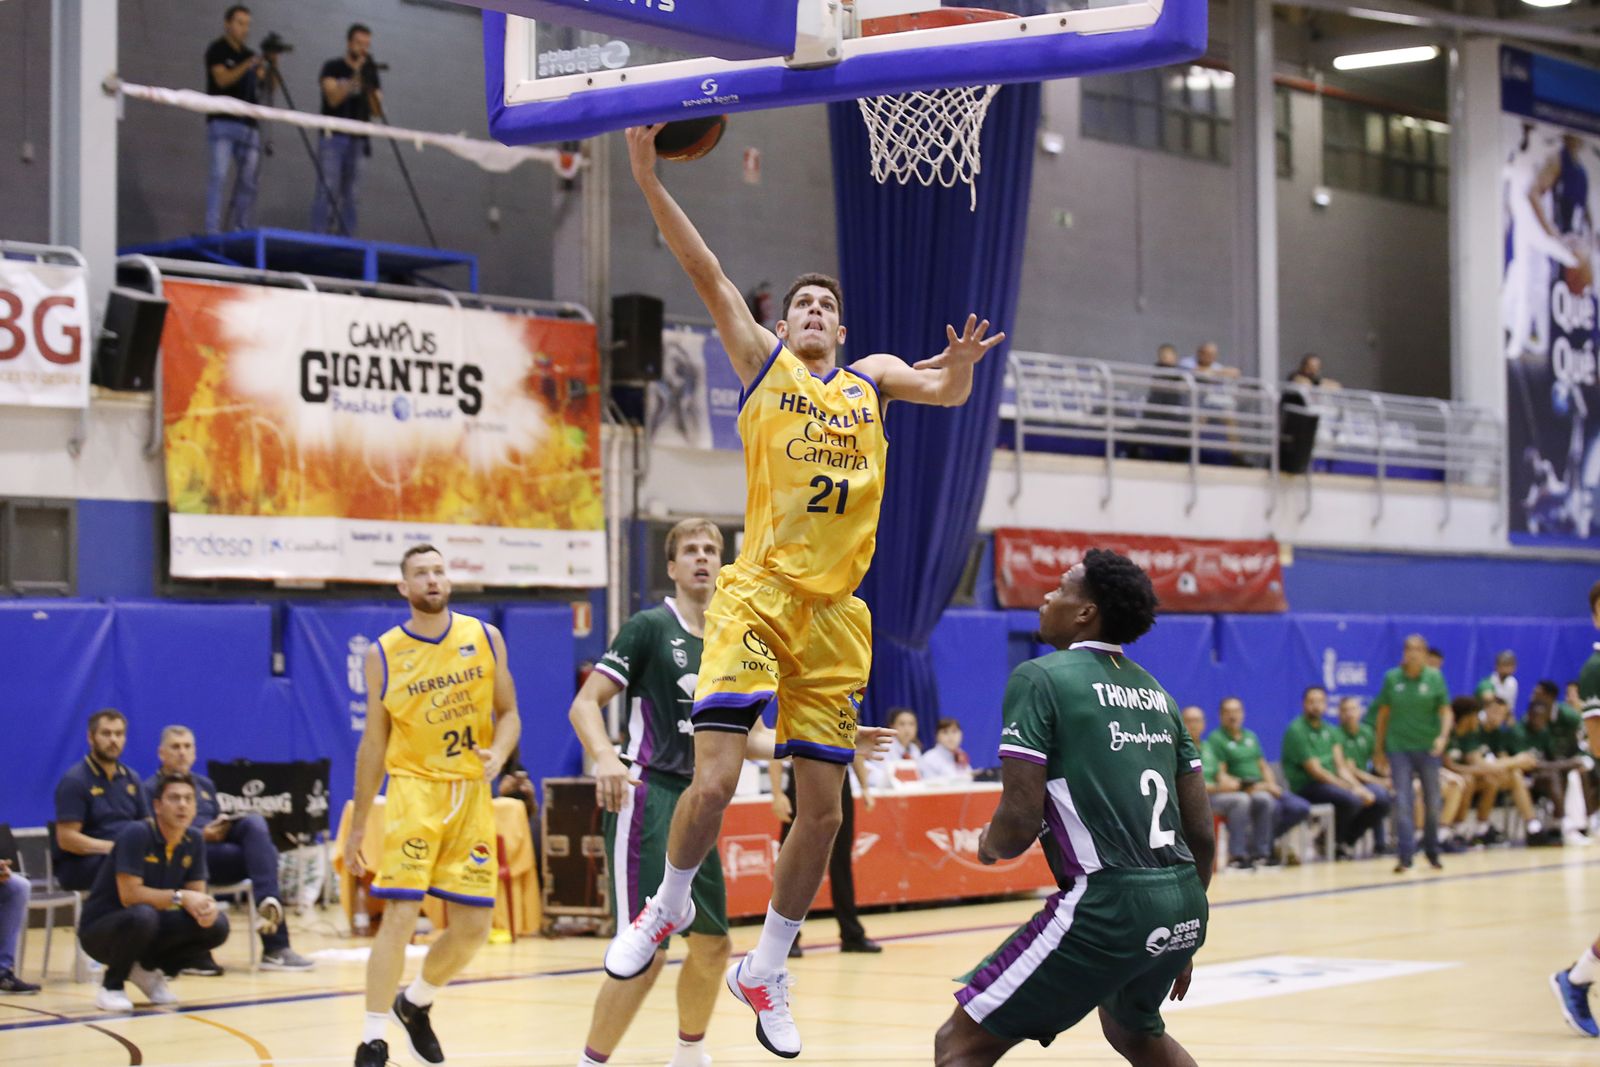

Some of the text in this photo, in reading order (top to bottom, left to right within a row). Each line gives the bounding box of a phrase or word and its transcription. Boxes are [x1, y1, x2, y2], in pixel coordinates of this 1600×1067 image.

[349, 321, 438, 355] CAMPUS
[301, 350, 484, 416] GIGANTES
[779, 392, 874, 428] HERBALIE
[804, 421, 857, 449] Gran
[786, 438, 868, 471] Canaria
[807, 475, 849, 515] 21
[407, 666, 484, 696] HERBALIFE
[741, 661, 778, 678] TOYO
[431, 689, 473, 709] Gran
[1092, 682, 1169, 714] THOMSON
[425, 704, 479, 725] Canar
[443, 725, 477, 757] 24
[1140, 769, 1175, 849] 2
[1173, 918, 1200, 935] COSTA
